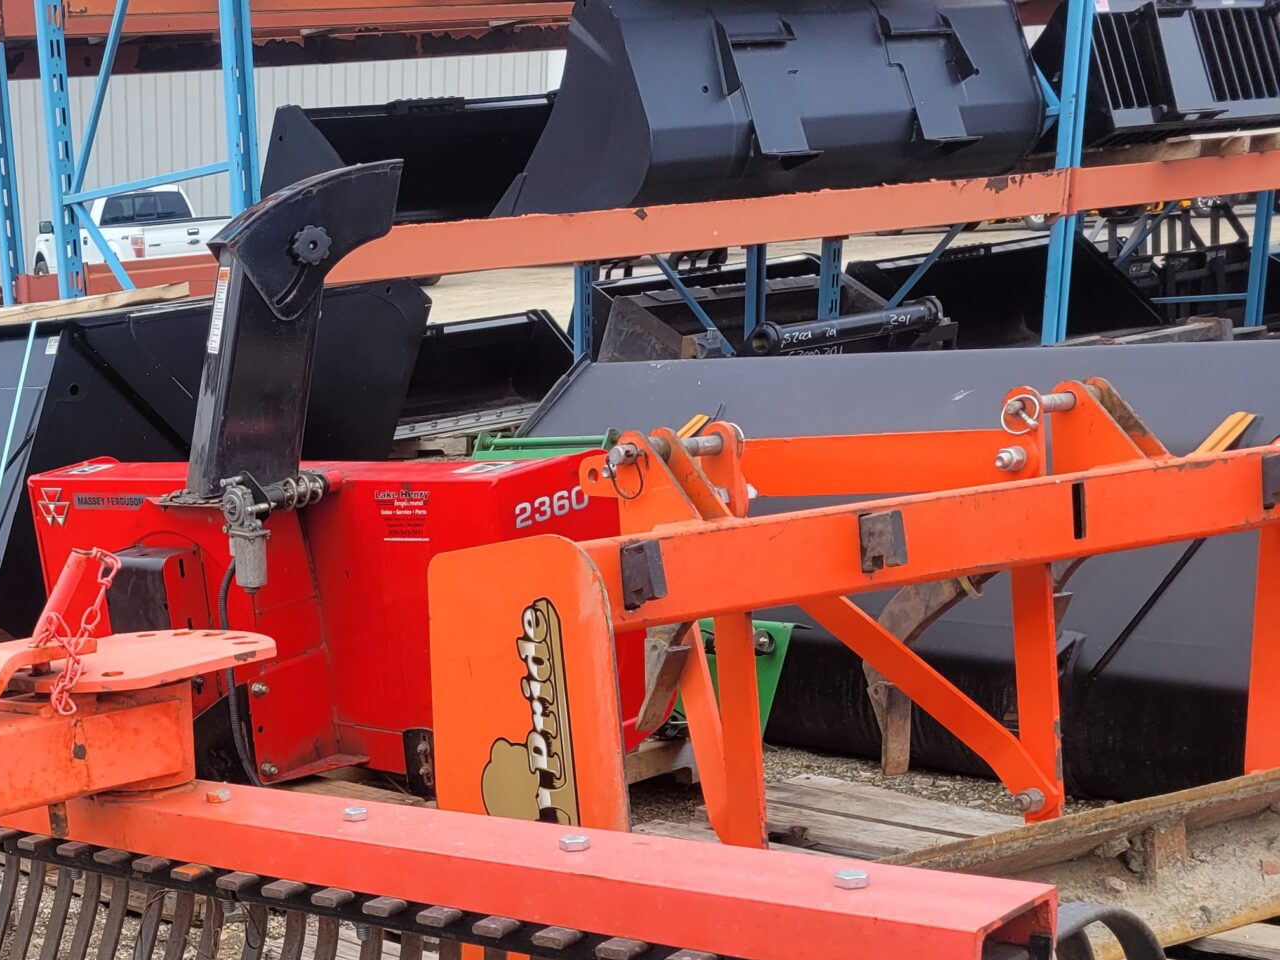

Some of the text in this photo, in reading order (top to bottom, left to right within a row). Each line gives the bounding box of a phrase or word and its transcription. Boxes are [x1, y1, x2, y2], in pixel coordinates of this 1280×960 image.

[889, 313, 912, 325] 201
[375, 489, 429, 501] Lake Henry
[77, 496, 145, 507] MASSEY FERGUSON
[514, 485, 589, 529] 2360
